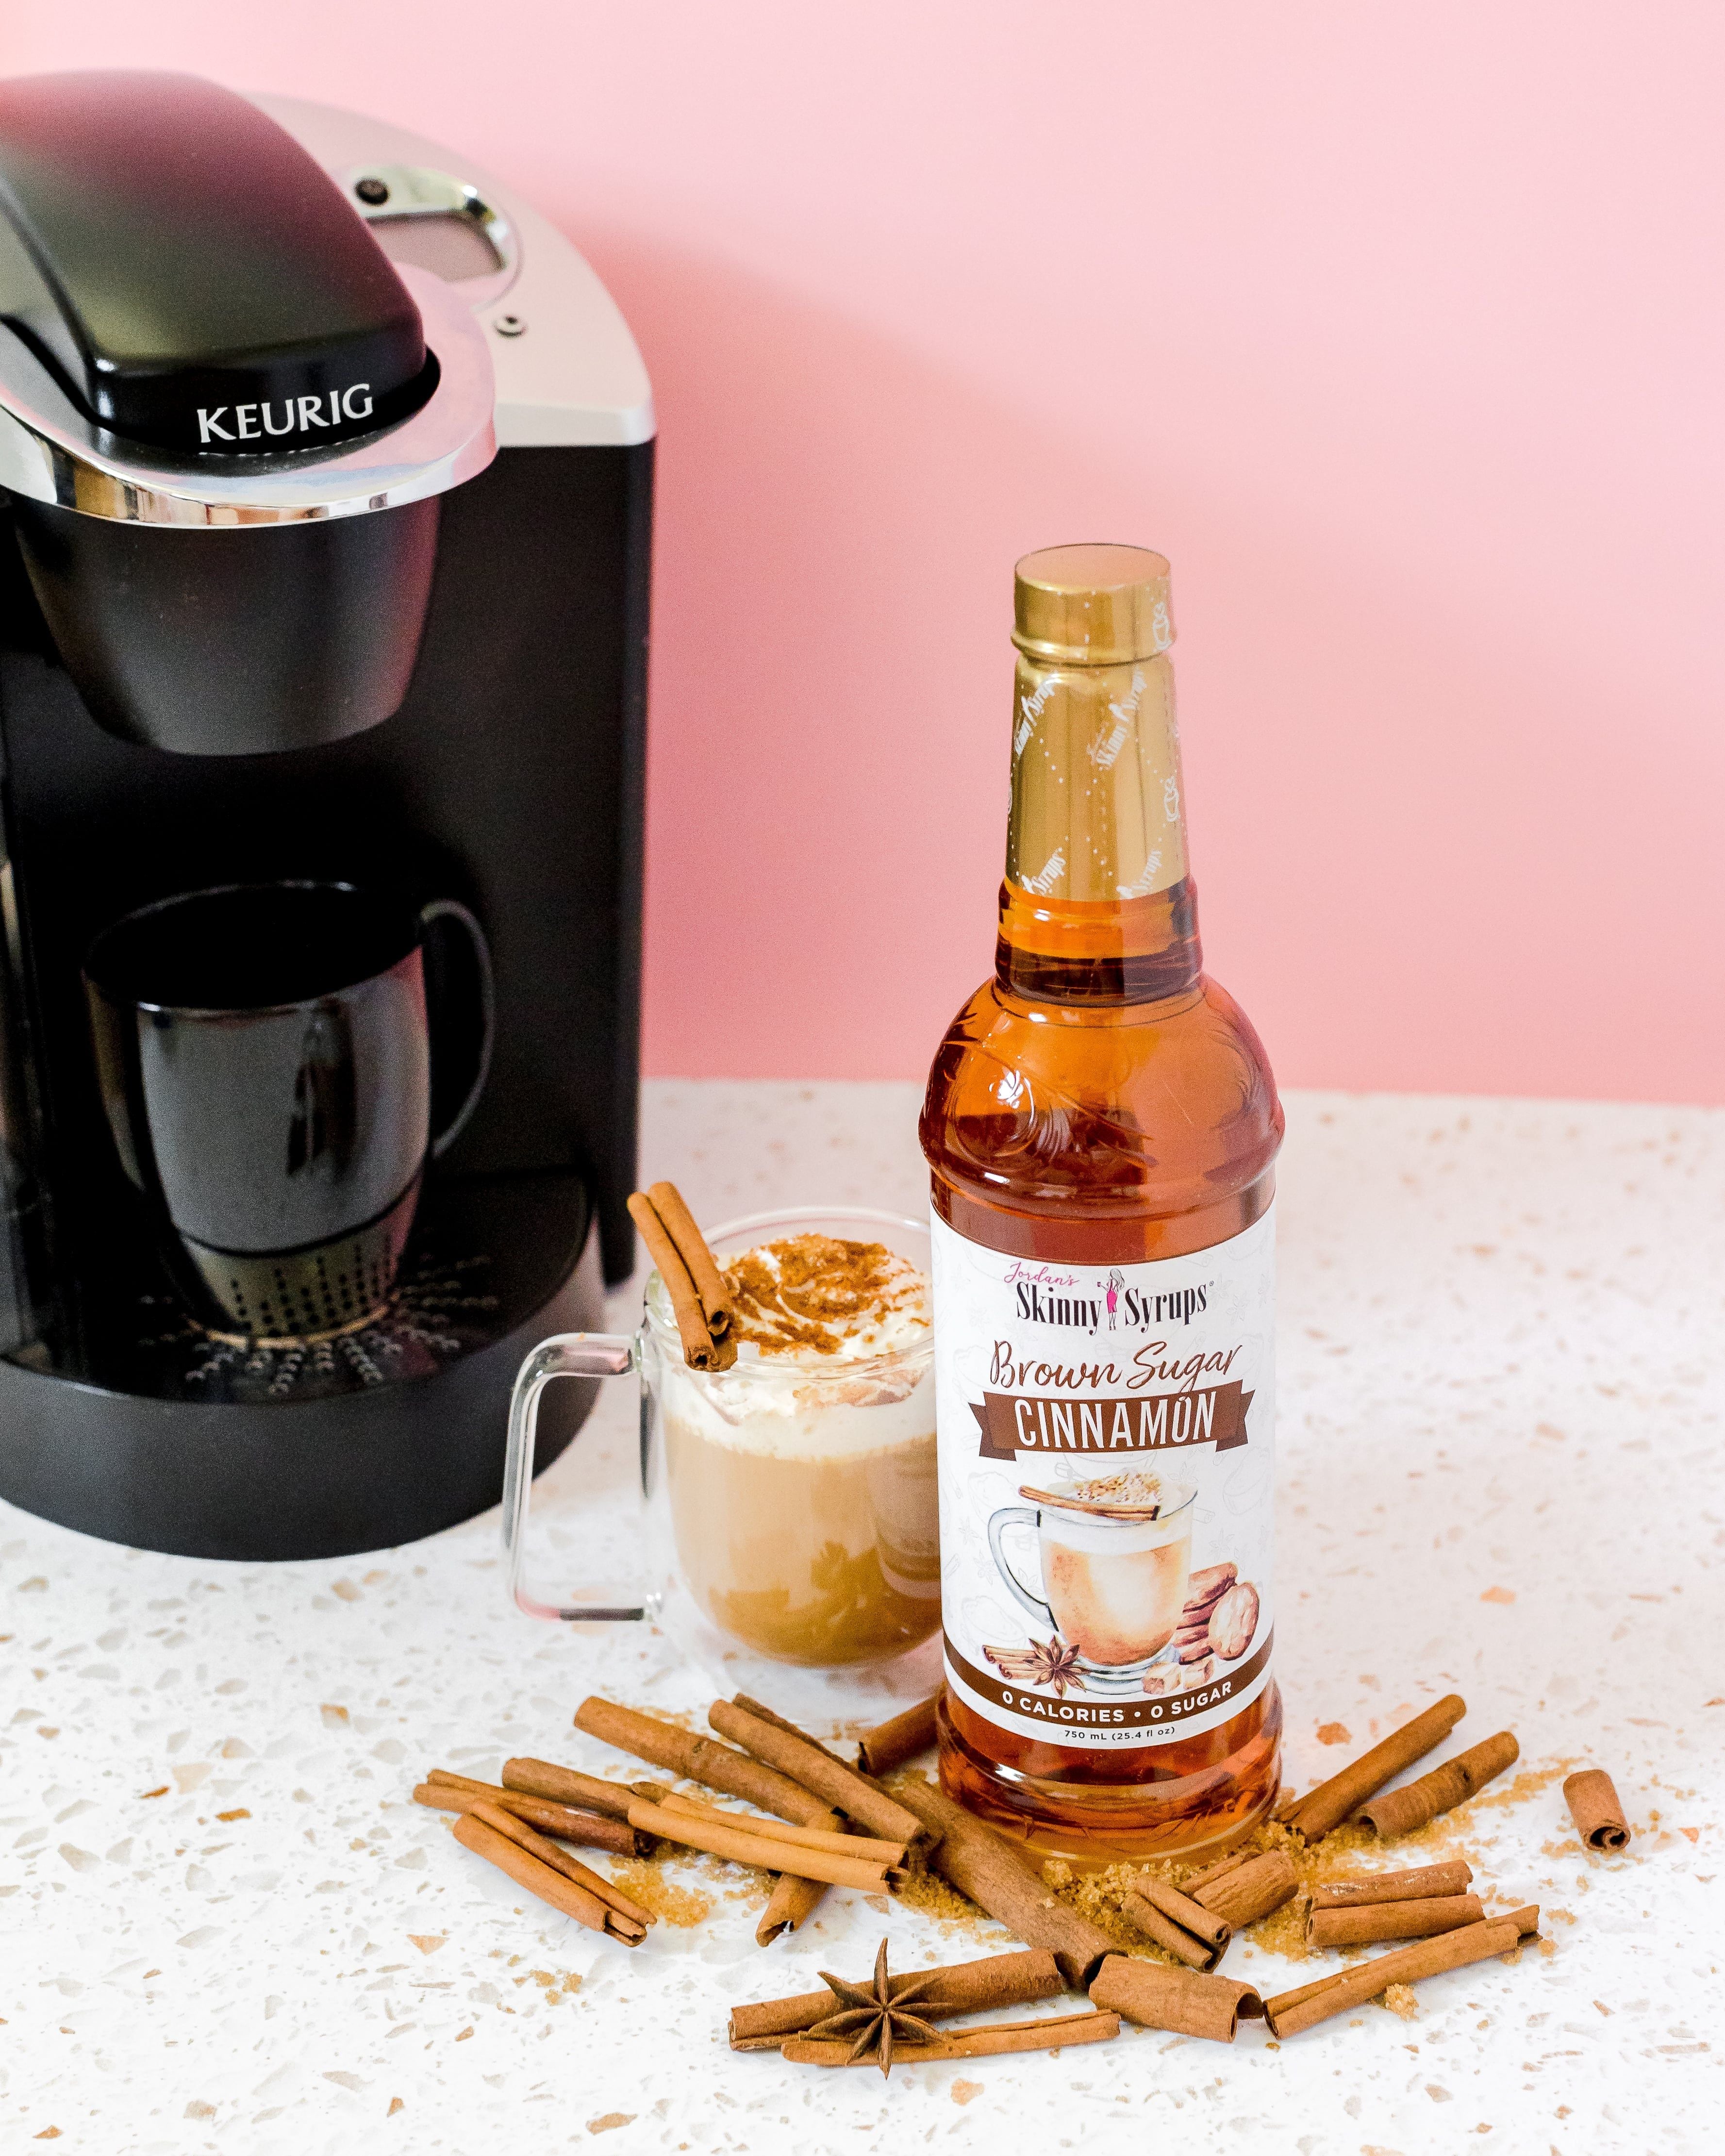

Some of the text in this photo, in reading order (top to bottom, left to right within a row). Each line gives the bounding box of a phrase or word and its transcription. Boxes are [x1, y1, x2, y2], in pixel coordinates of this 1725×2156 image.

[197, 383, 373, 443] KEURIG
[1004, 1261, 1080, 1286] Jordan's
[1016, 1281, 1102, 1336] Skinny
[990, 1340, 1243, 1400] Brown Sugar
[1016, 1391, 1217, 1449] CINNAMON
[1002, 1681, 1232, 1722] 0 CALORIES 0 SUGAR
[1064, 1730, 1085, 1739] 750
[1112, 1731, 1142, 1741] (25.4
[1158, 1726, 1175, 1735] oz)
